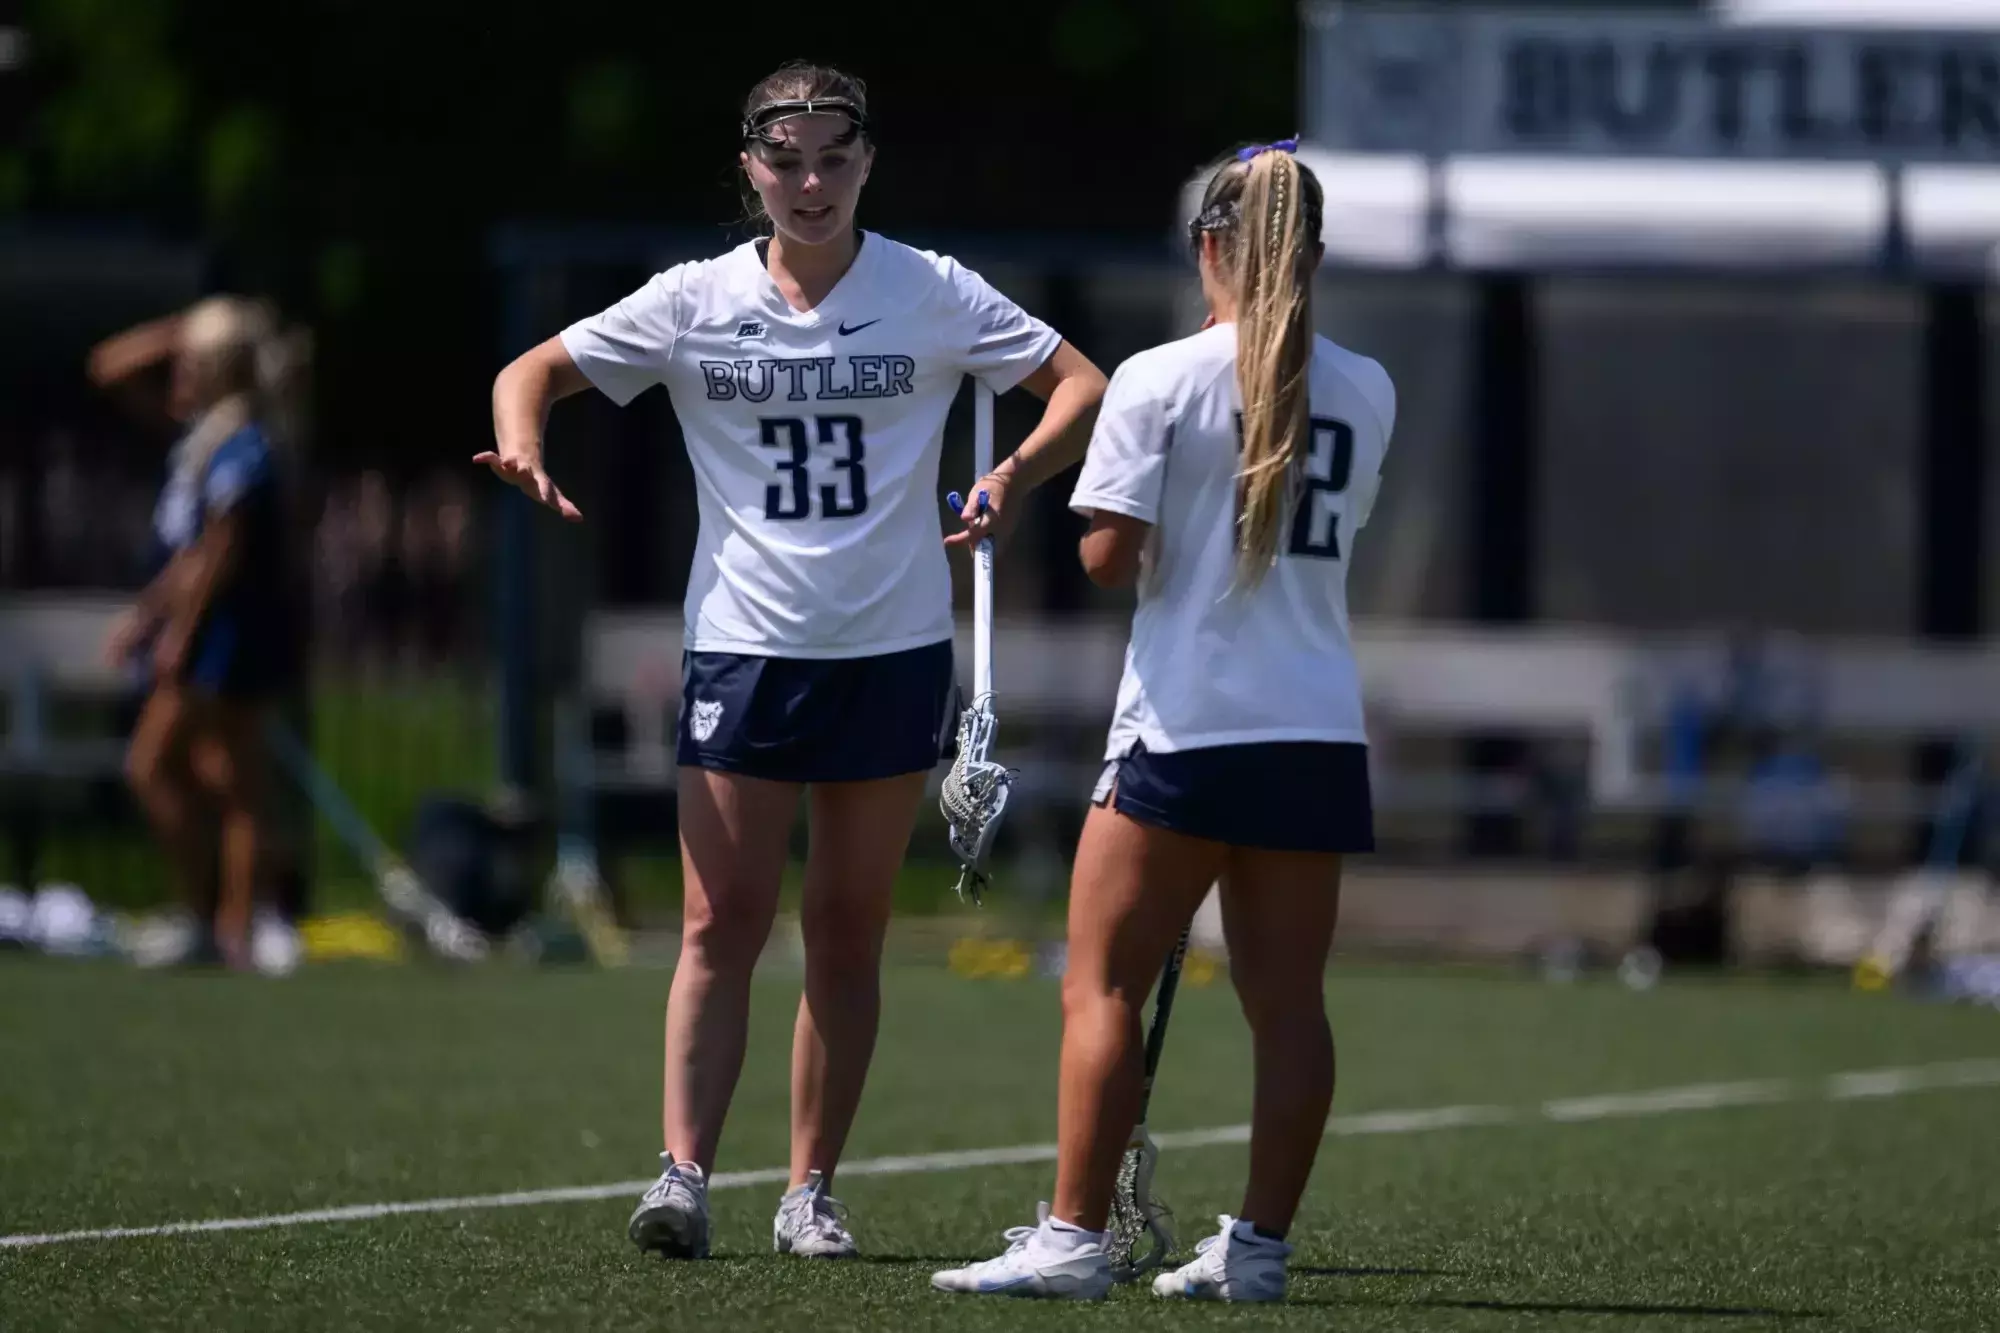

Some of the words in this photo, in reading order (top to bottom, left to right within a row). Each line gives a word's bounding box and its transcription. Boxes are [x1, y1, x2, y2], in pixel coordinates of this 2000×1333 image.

[1503, 35, 2000, 147] BUTLER
[701, 354, 915, 403] BUTLER
[759, 414, 869, 520] 33
